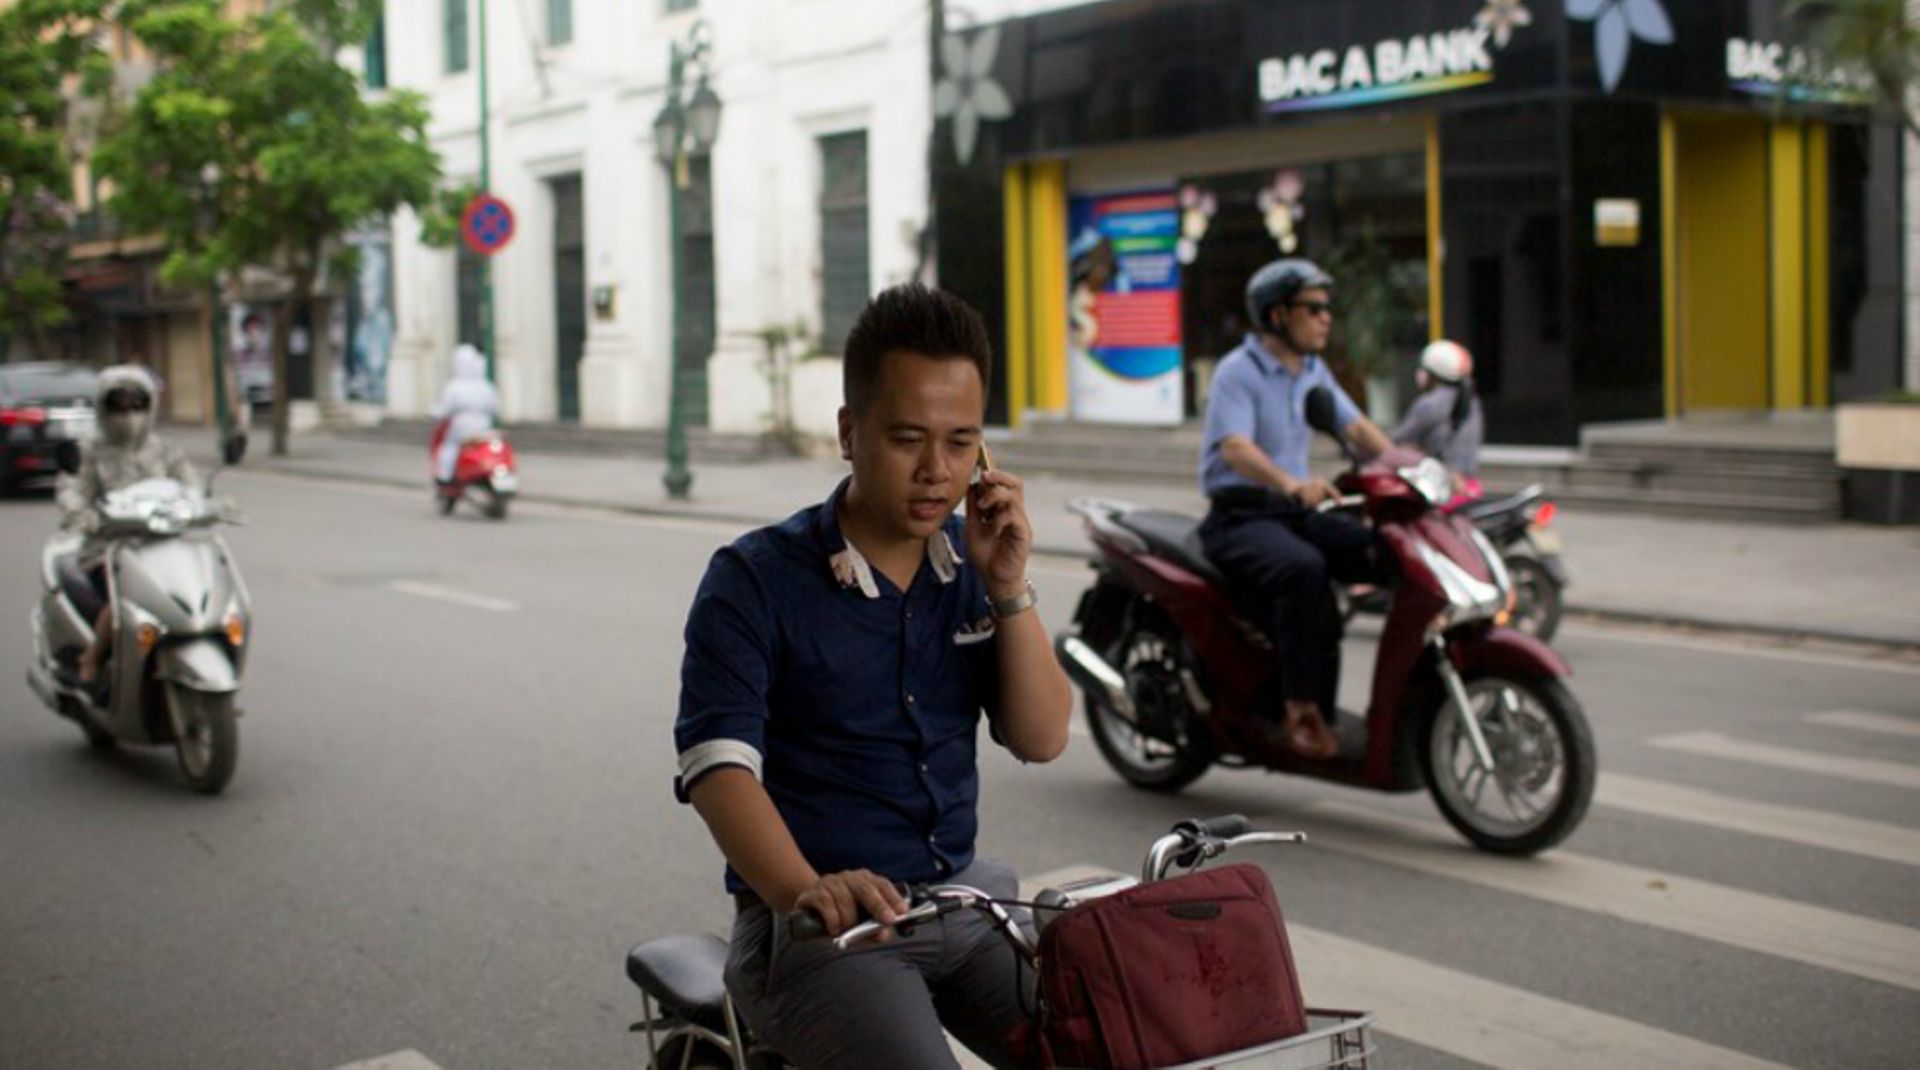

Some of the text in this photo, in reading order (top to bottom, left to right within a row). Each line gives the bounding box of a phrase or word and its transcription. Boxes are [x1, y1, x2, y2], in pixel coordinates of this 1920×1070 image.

[1258, 27, 1493, 101] BAC A BANK
[1726, 38, 1784, 82] BAC
